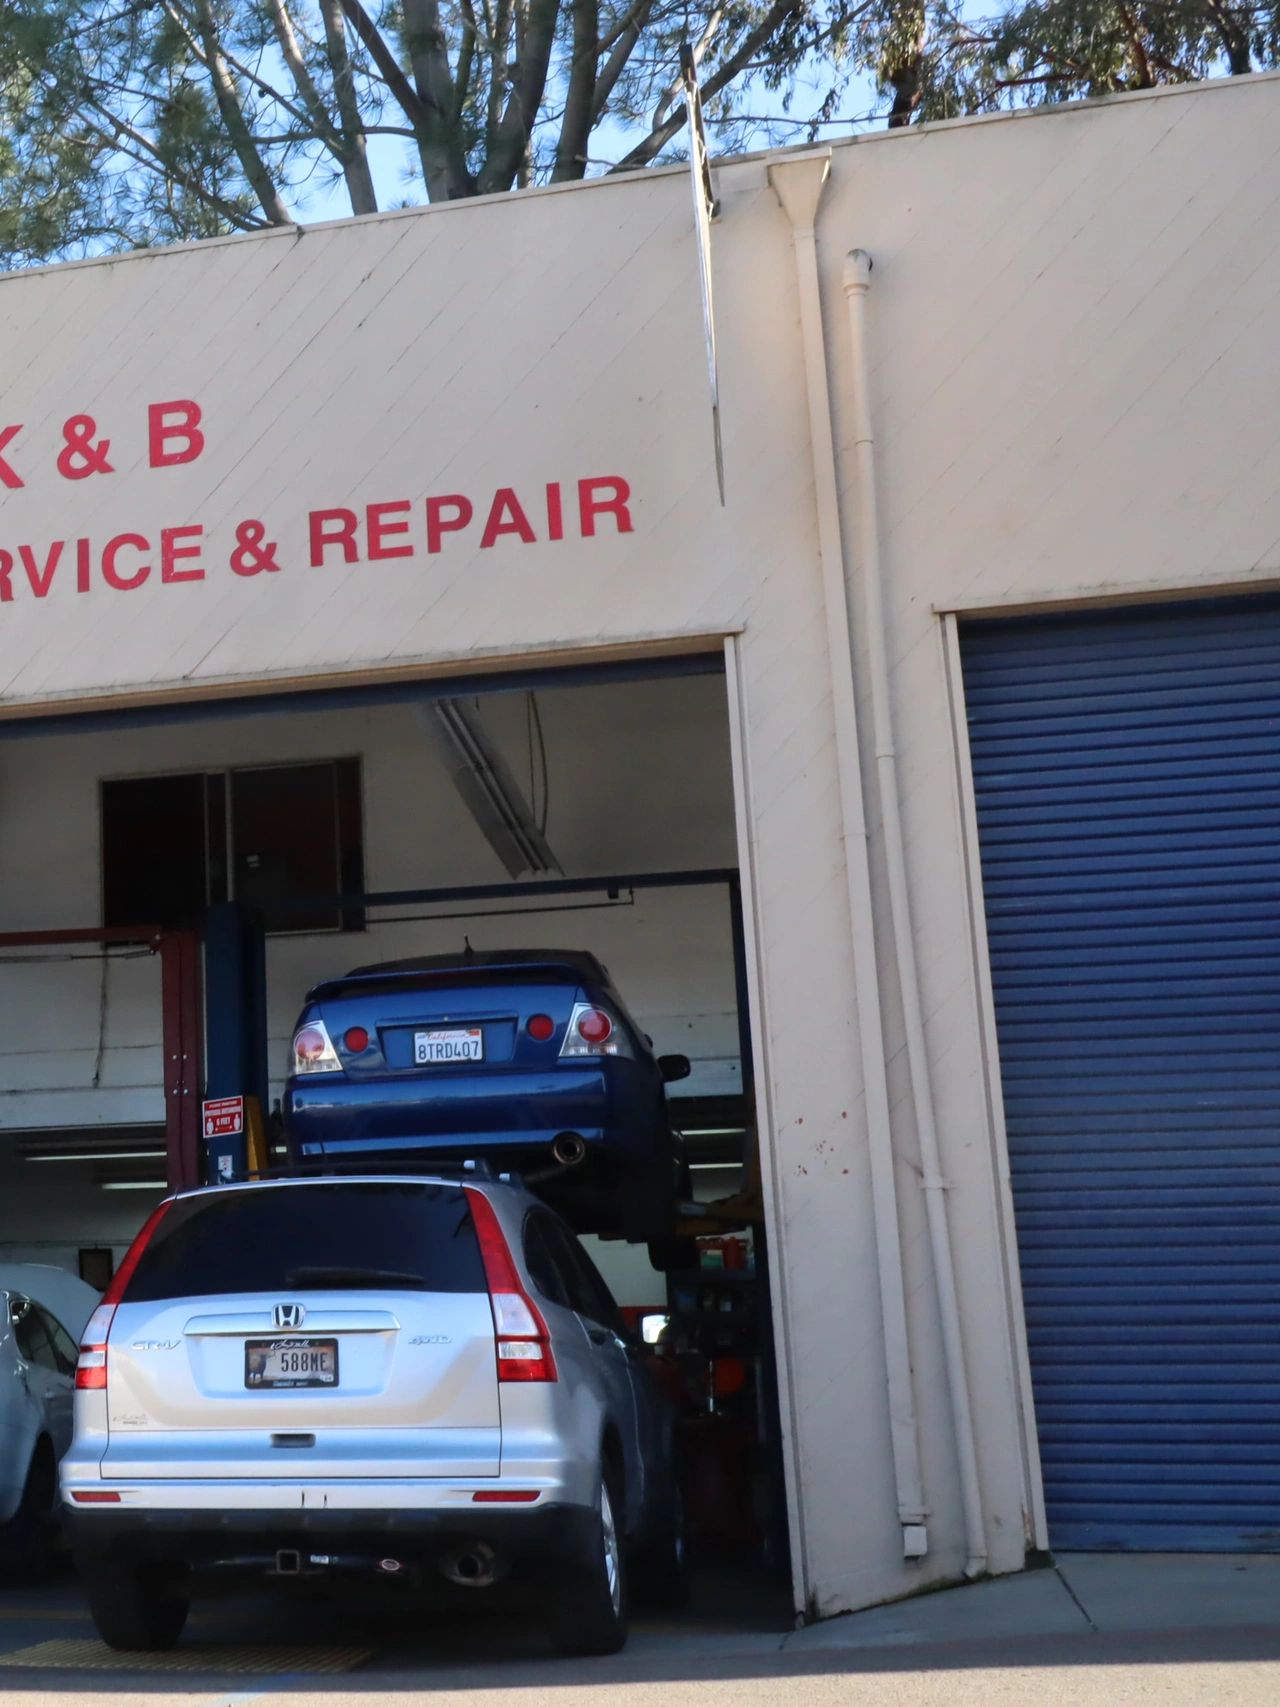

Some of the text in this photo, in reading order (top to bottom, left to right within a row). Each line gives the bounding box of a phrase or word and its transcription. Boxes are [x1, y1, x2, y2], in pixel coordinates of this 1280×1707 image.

[56, 414, 114, 480] &
[148, 400, 205, 467] B
[230, 520, 280, 577] &
[309, 475, 634, 567] REPAIR
[418, 1041, 479, 1060] 8TRD407
[281, 1352, 329, 1372] 588ME
